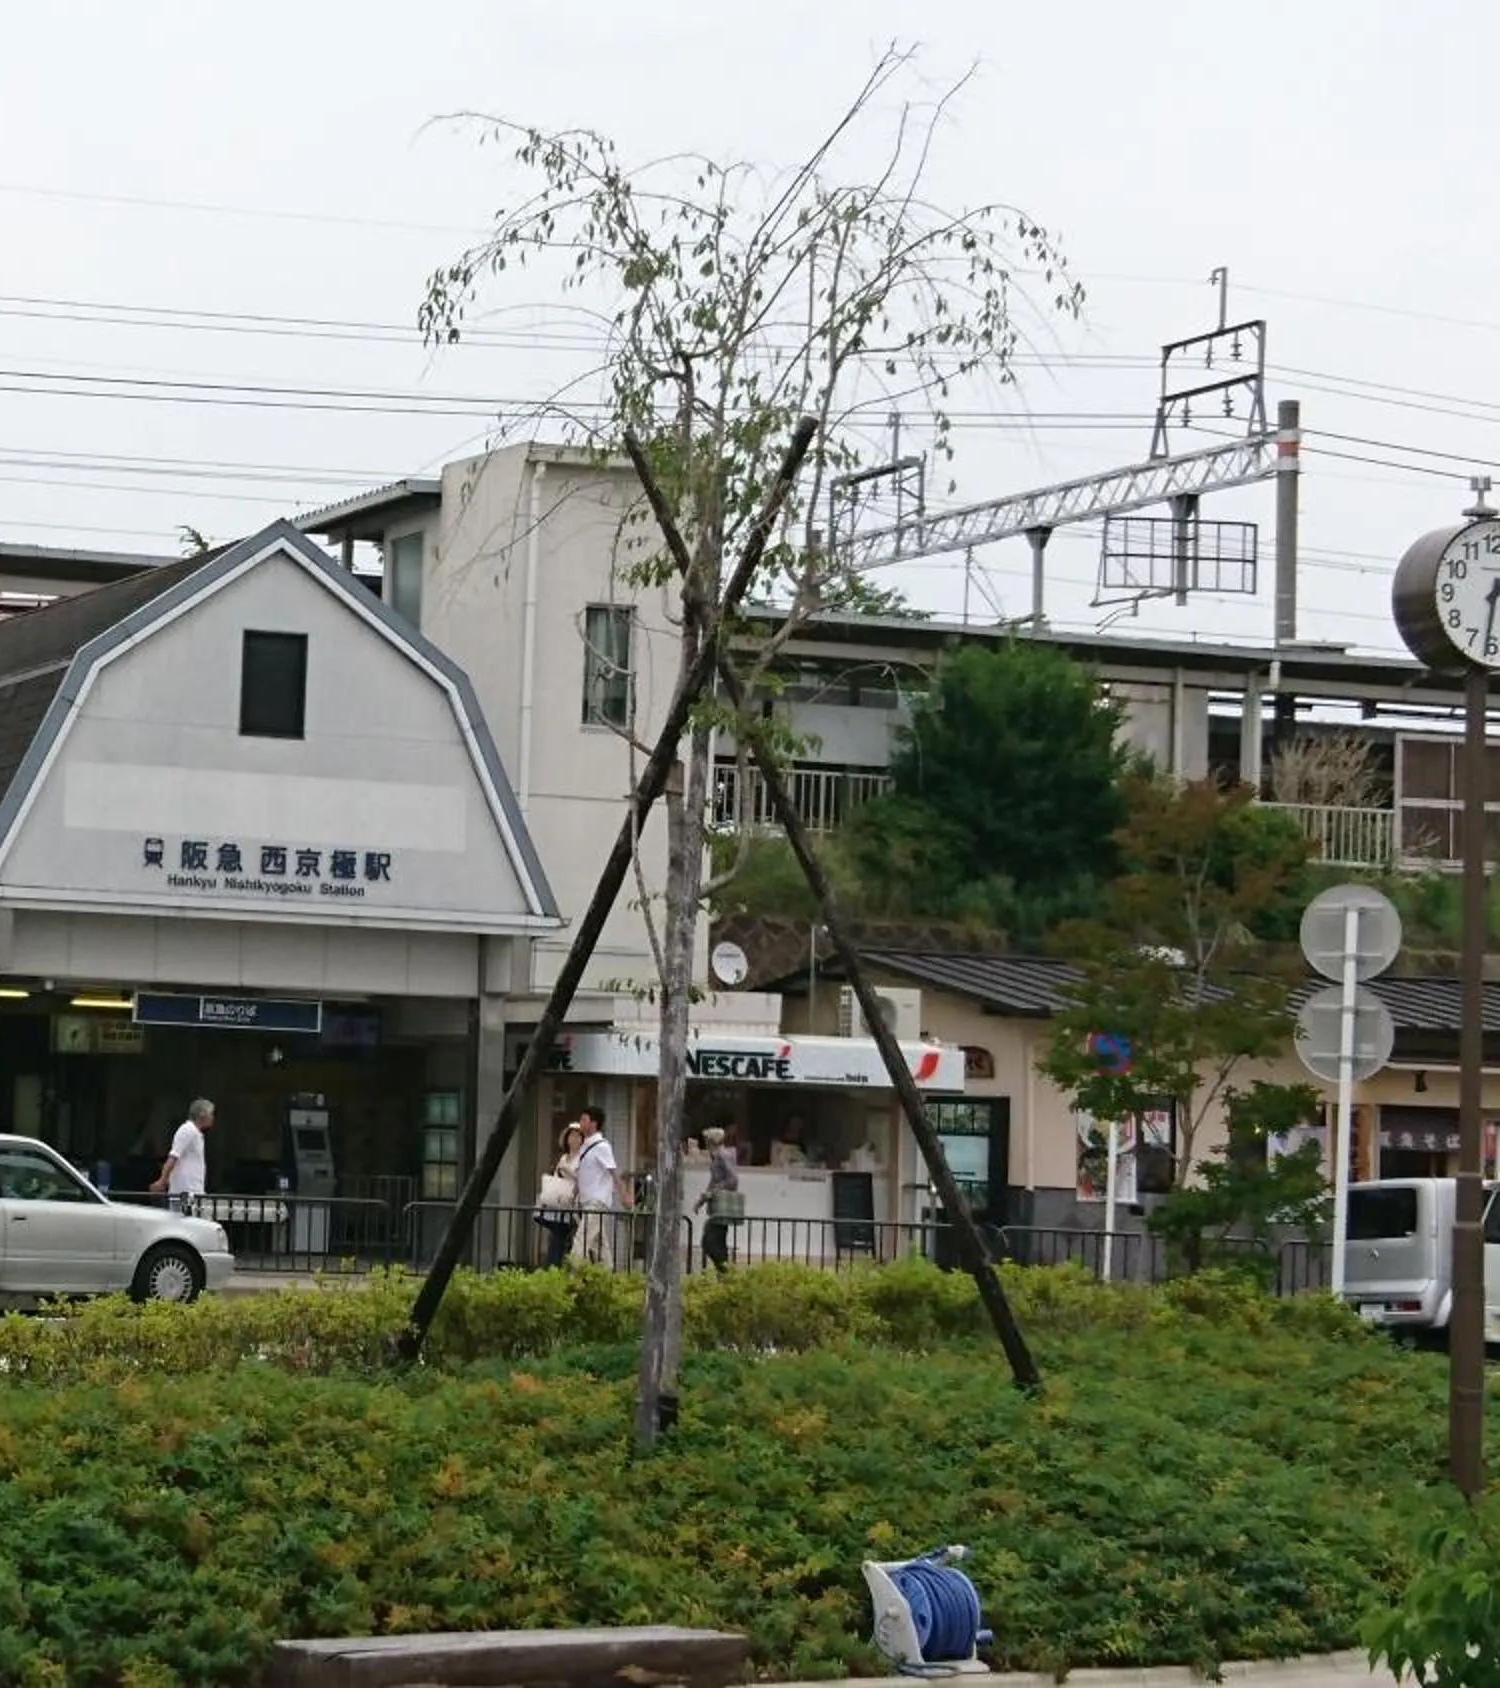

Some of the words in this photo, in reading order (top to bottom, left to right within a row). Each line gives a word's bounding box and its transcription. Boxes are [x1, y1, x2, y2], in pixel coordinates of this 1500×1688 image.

[1462, 542, 1479, 560] 11
[1448, 560, 1467, 580] 10
[1441, 583, 1454, 602] 9
[1449, 609, 1461, 629] 8
[1465, 628, 1479, 648] 7
[1486, 636, 1499, 656] 6
[180, 840, 243, 873] 阪急
[260, 845, 391, 881] 西京極駅
[167, 873, 217, 890] Hankyu
[224, 877, 312, 895] Nishikyogoku
[319, 883, 365, 897] Station
